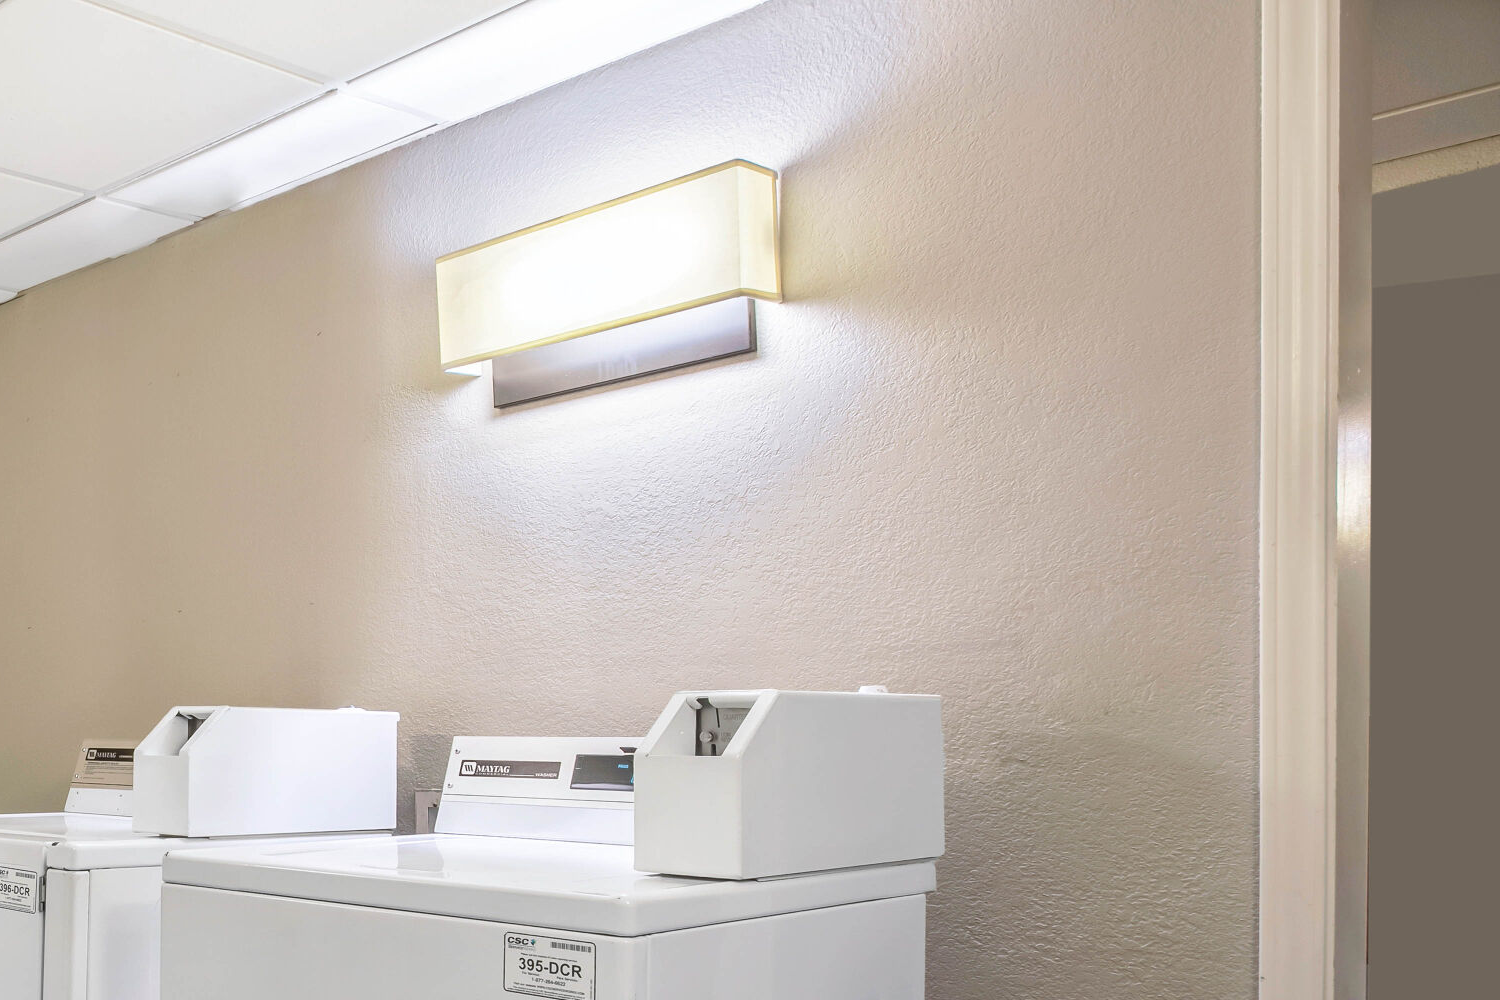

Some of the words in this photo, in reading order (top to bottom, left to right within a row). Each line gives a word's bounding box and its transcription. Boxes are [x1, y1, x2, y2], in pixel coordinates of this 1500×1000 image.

[476, 765, 510, 774] MAYTAG
[0, 883, 30, 896] 396-DCR
[507, 936, 529, 945] CSC
[519, 957, 582, 978] 395-DCR
